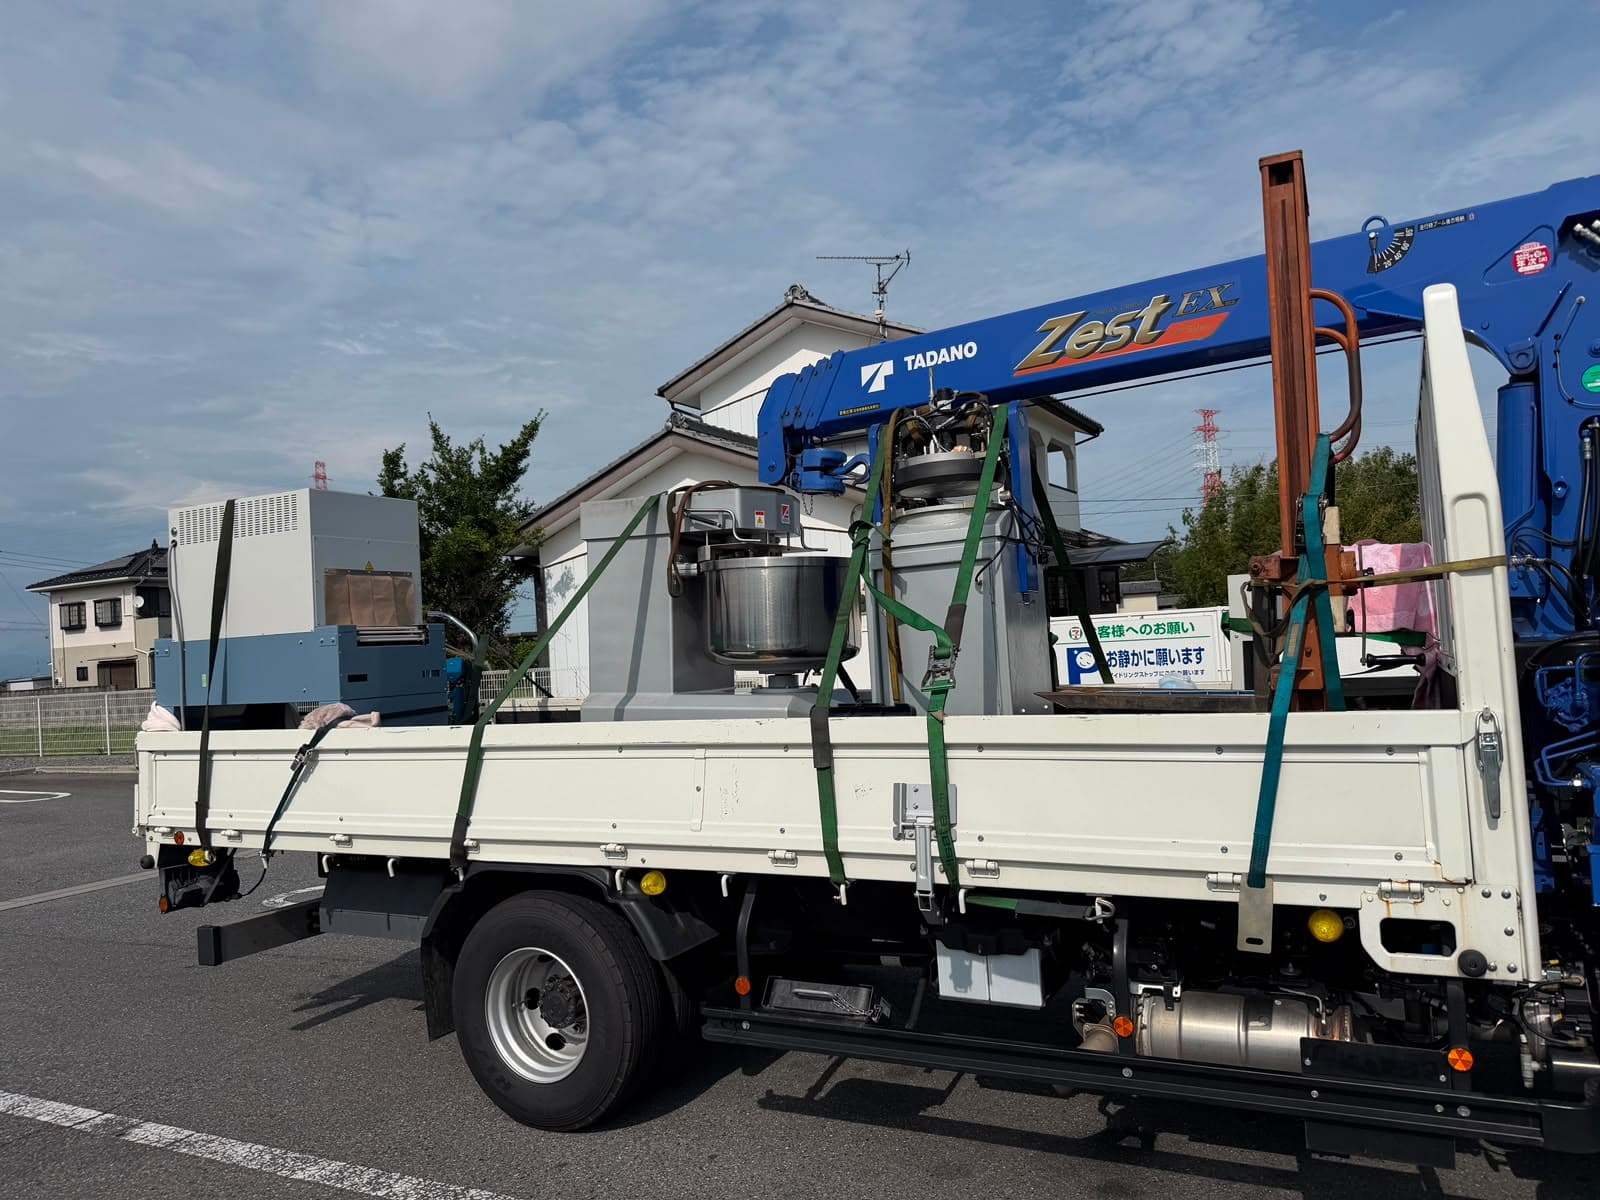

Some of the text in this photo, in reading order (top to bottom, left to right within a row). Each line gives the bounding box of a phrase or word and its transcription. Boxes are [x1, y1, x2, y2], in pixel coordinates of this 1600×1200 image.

[1013, 282, 1239, 370] Zest EX
[904, 341, 978, 371] TADANO
[1096, 621, 1196, 639] 客様へのお願い
[1106, 646, 1205, 668] お静かに願います
